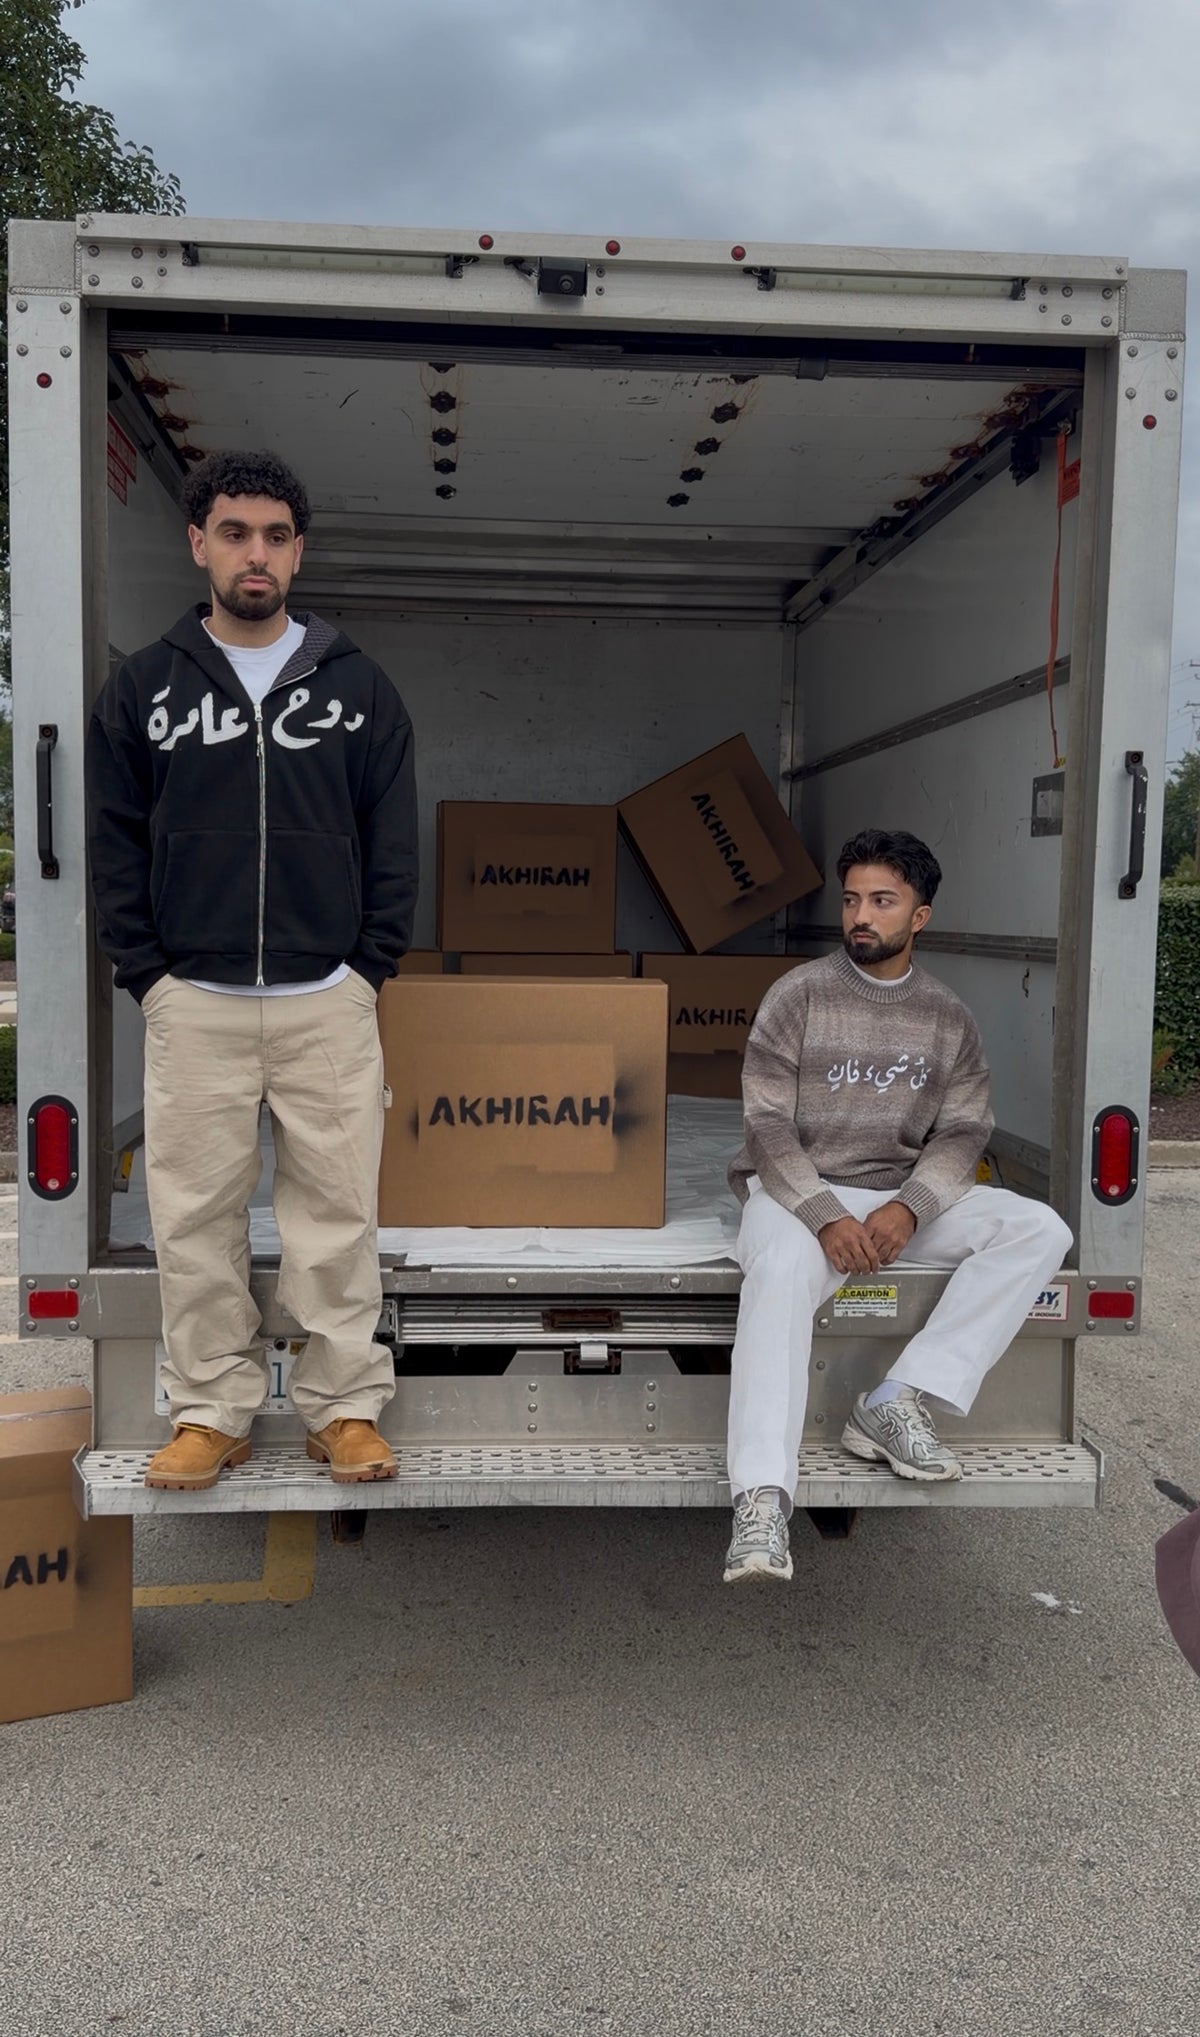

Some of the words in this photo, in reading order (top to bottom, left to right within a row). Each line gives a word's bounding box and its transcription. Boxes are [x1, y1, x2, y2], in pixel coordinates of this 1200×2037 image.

[690, 793, 756, 891] AKHIRAH
[480, 863, 591, 888] AKHIRAH
[428, 1094, 610, 1127] AKHIRAH
[850, 1290, 890, 1298] CAUTION
[0, 1543, 68, 1590] AH
